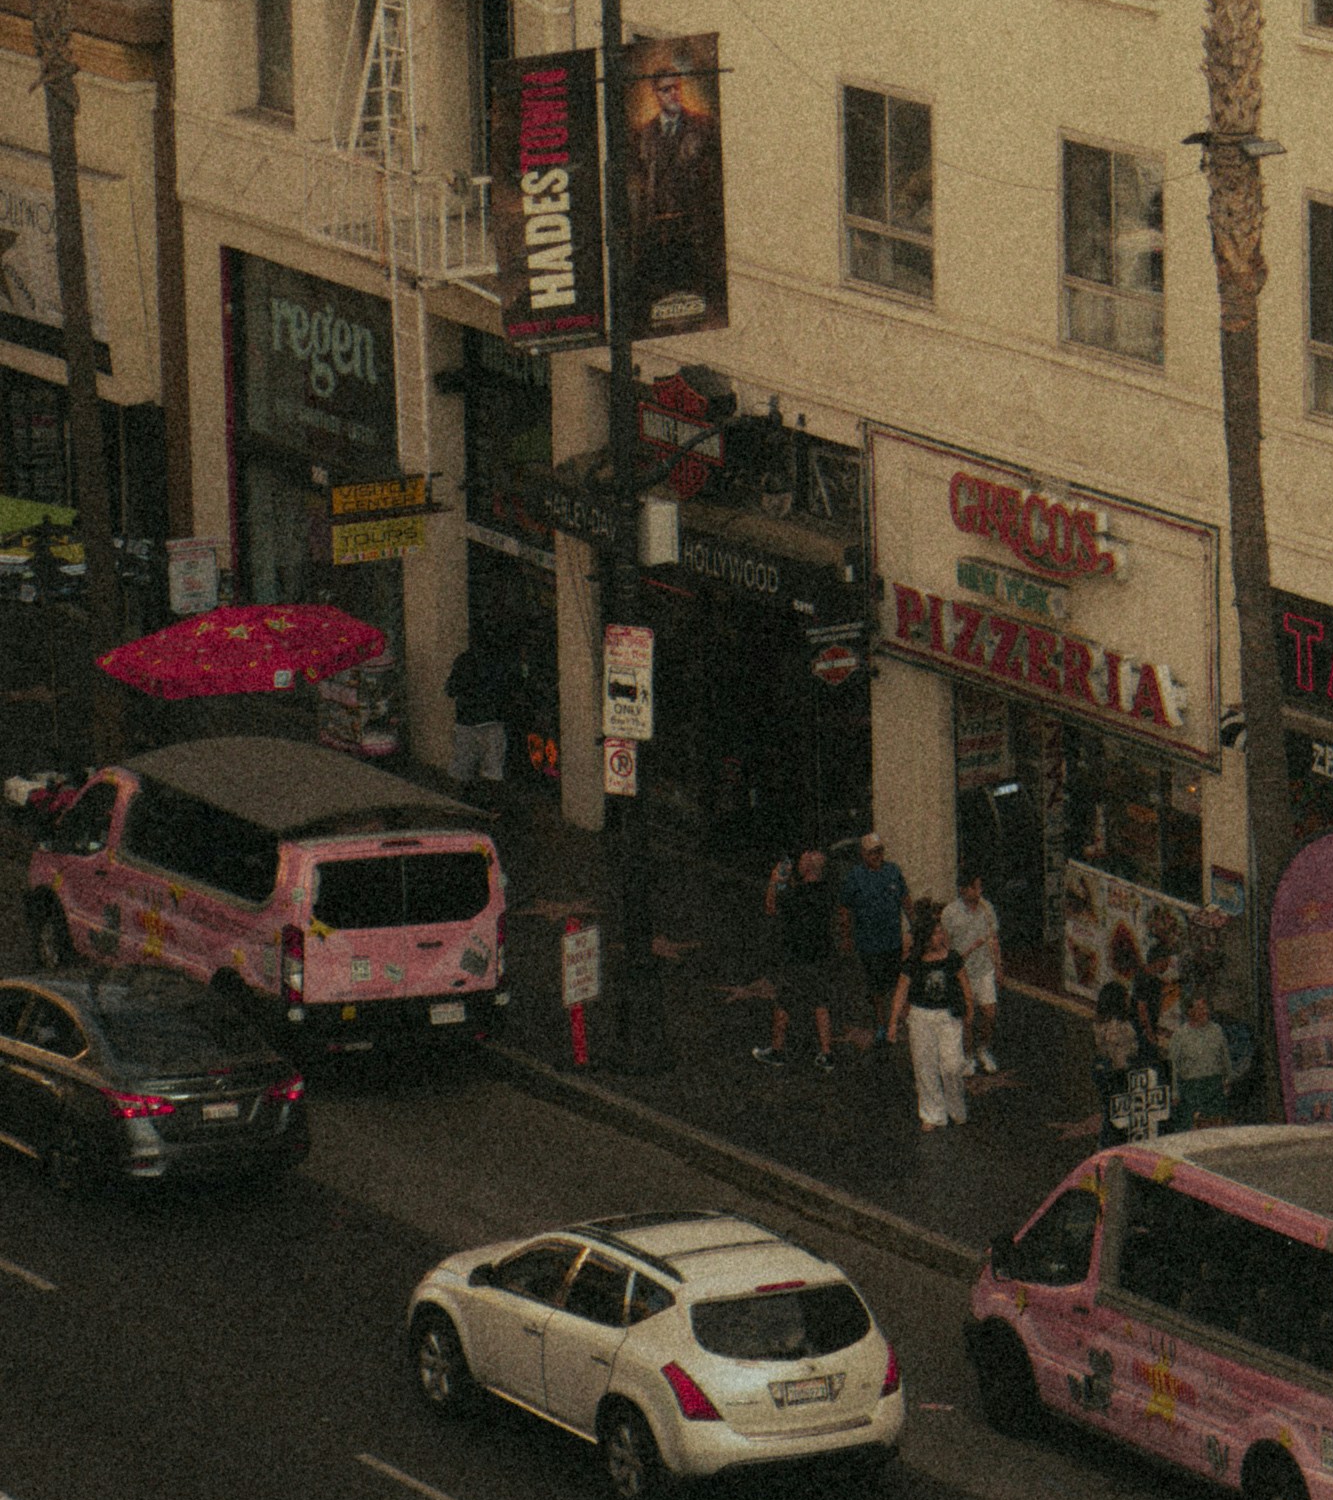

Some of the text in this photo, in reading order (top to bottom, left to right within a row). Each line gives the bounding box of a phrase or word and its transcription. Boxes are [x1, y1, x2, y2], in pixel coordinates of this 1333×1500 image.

[520, 68, 577, 310] HADESTOWN
[271, 297, 377, 398] regen
[893, 583, 1174, 728] PIZZERIA
